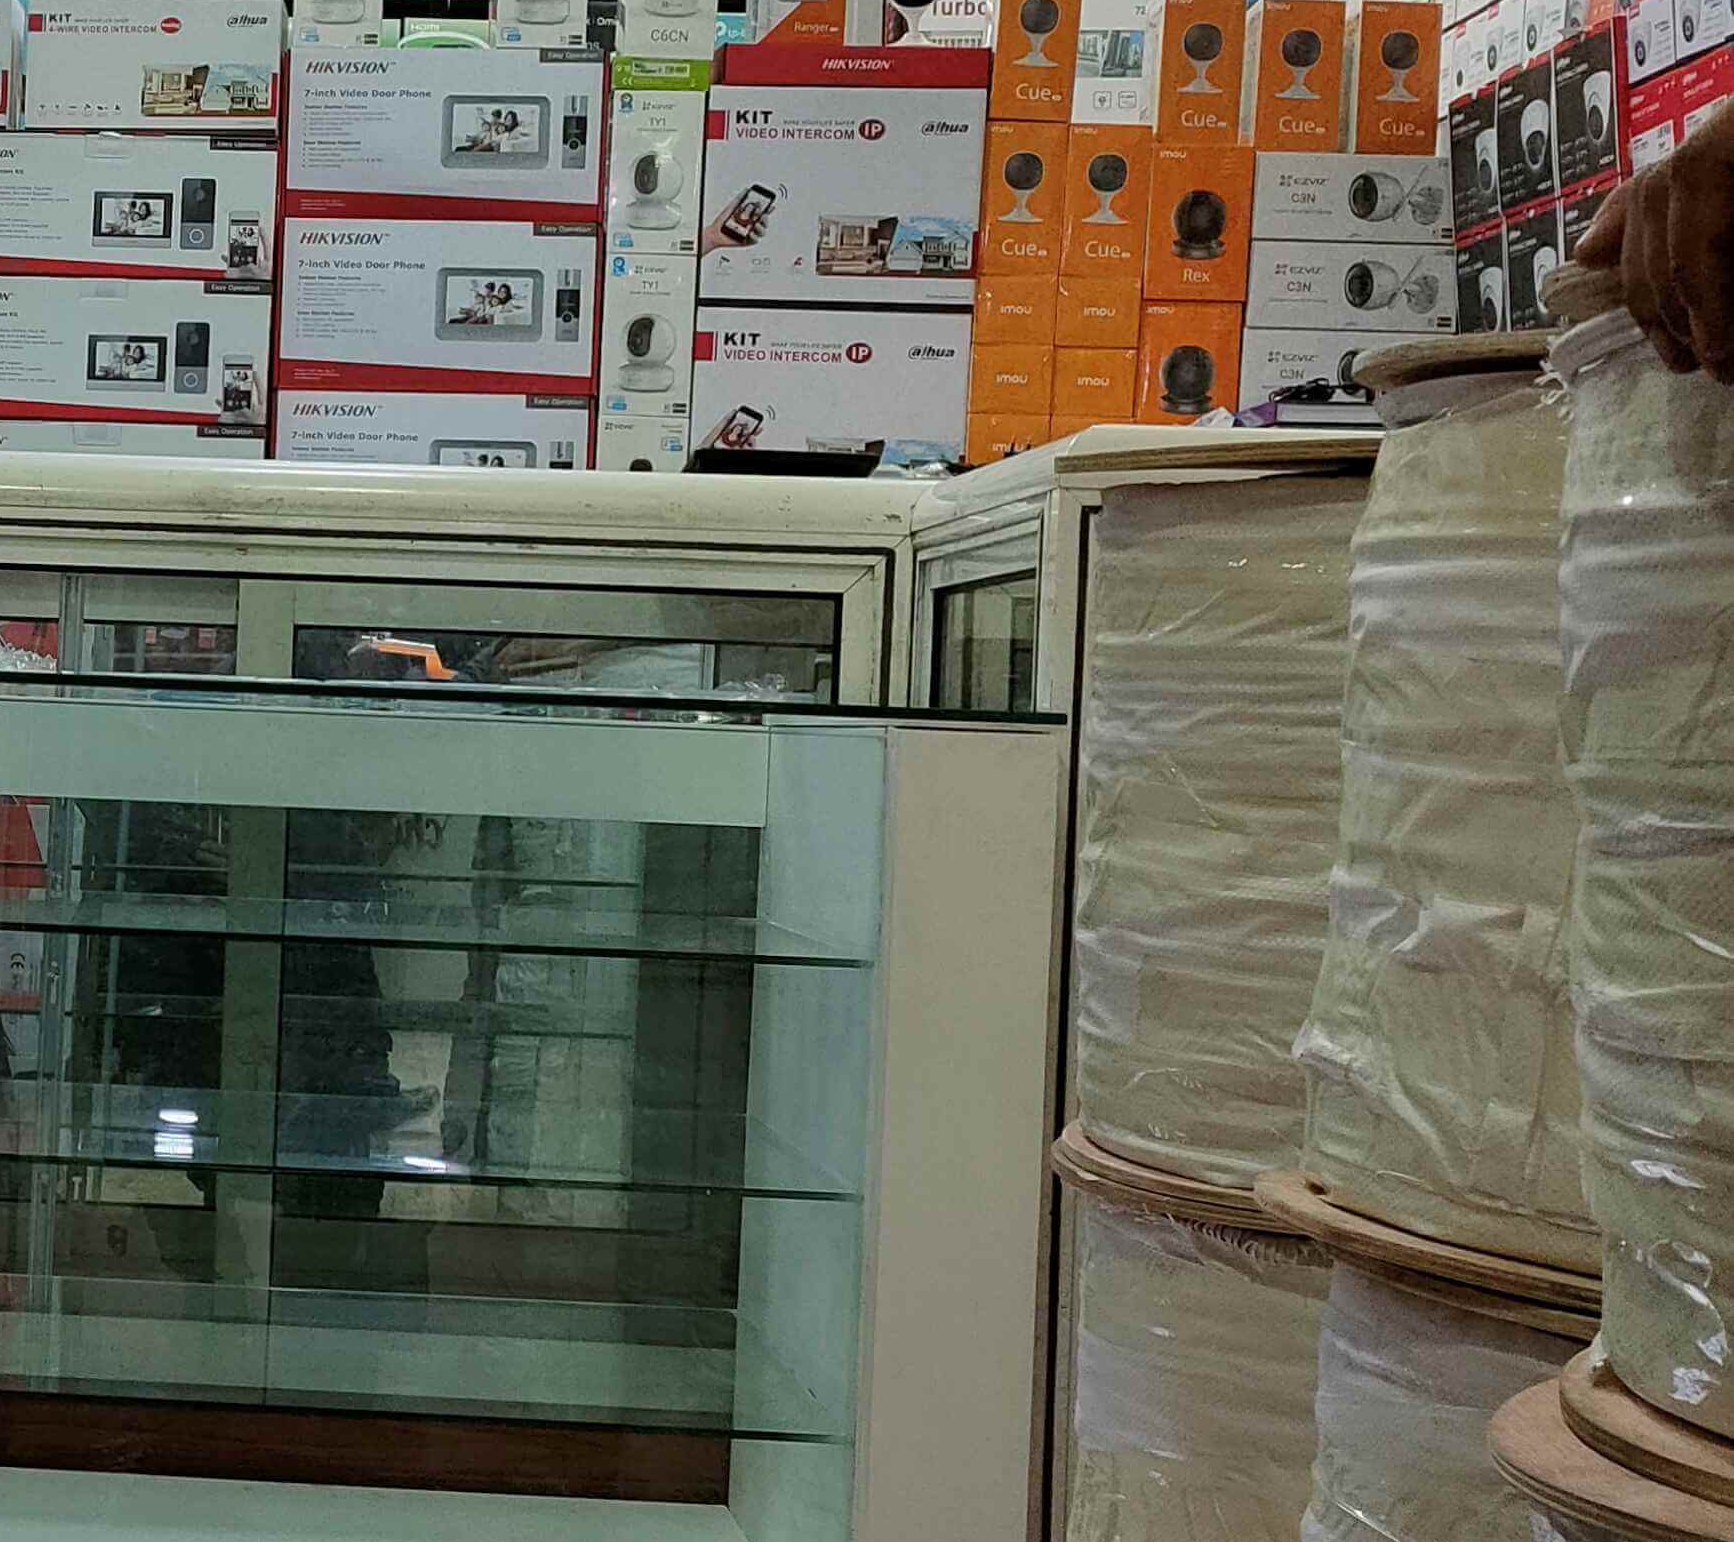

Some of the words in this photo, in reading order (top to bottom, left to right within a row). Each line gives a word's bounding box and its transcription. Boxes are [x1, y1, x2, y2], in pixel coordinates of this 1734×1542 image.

[48, 13, 73, 23] KIT
[82, 25, 109, 34] VIDEO
[110, 26, 157, 35] INTERCOM
[794, 21, 830, 35] Ranger
[650, 28, 690, 44] C6CN
[304, 60, 390, 76] HIKVISION
[821, 58, 892, 71] HIKVISION
[303, 87, 337, 99] 7-inch
[339, 87, 369, 99] Video
[370, 87, 397, 99] Door
[398, 88, 433, 99] Phone
[1015, 82, 1052, 100] Cue
[735, 109, 774, 124] KIT
[1180, 110, 1218, 127] Cue
[1278, 116, 1316, 134] Cue
[1378, 117, 1417, 136] Cue
[735, 126, 779, 139] VIDEO
[781, 127, 856, 141] INTERCOM
[1290, 192, 1317, 205] C3N
[298, 231, 385, 246] HIKVISION
[1001, 238, 1038, 256] Cue
[1084, 240, 1122, 258] Cue
[298, 259, 332, 270] 7-inch
[333, 259, 363, 270] Video
[365, 259, 391, 271] Door
[393, 260, 427, 271] Phone
[1182, 267, 1211, 283] Rex
[1286, 281, 1312, 293] C3N
[1000, 304, 1033, 315] imou
[1083, 307, 1116, 317] imou
[723, 331, 762, 346] KIT
[723, 348, 767, 361] VIDEO
[769, 349, 843, 363] INTERCOM
[996, 373, 1028, 384] imou
[1077, 376, 1110, 386] imou
[1279, 368, 1305, 380] C3N
[291, 403, 377, 418] HIKVISION
[291, 430, 324, 442] 7-inch
[326, 431, 356, 442] Video
[358, 431, 384, 443] Door
[385, 432, 419, 443] Phone
